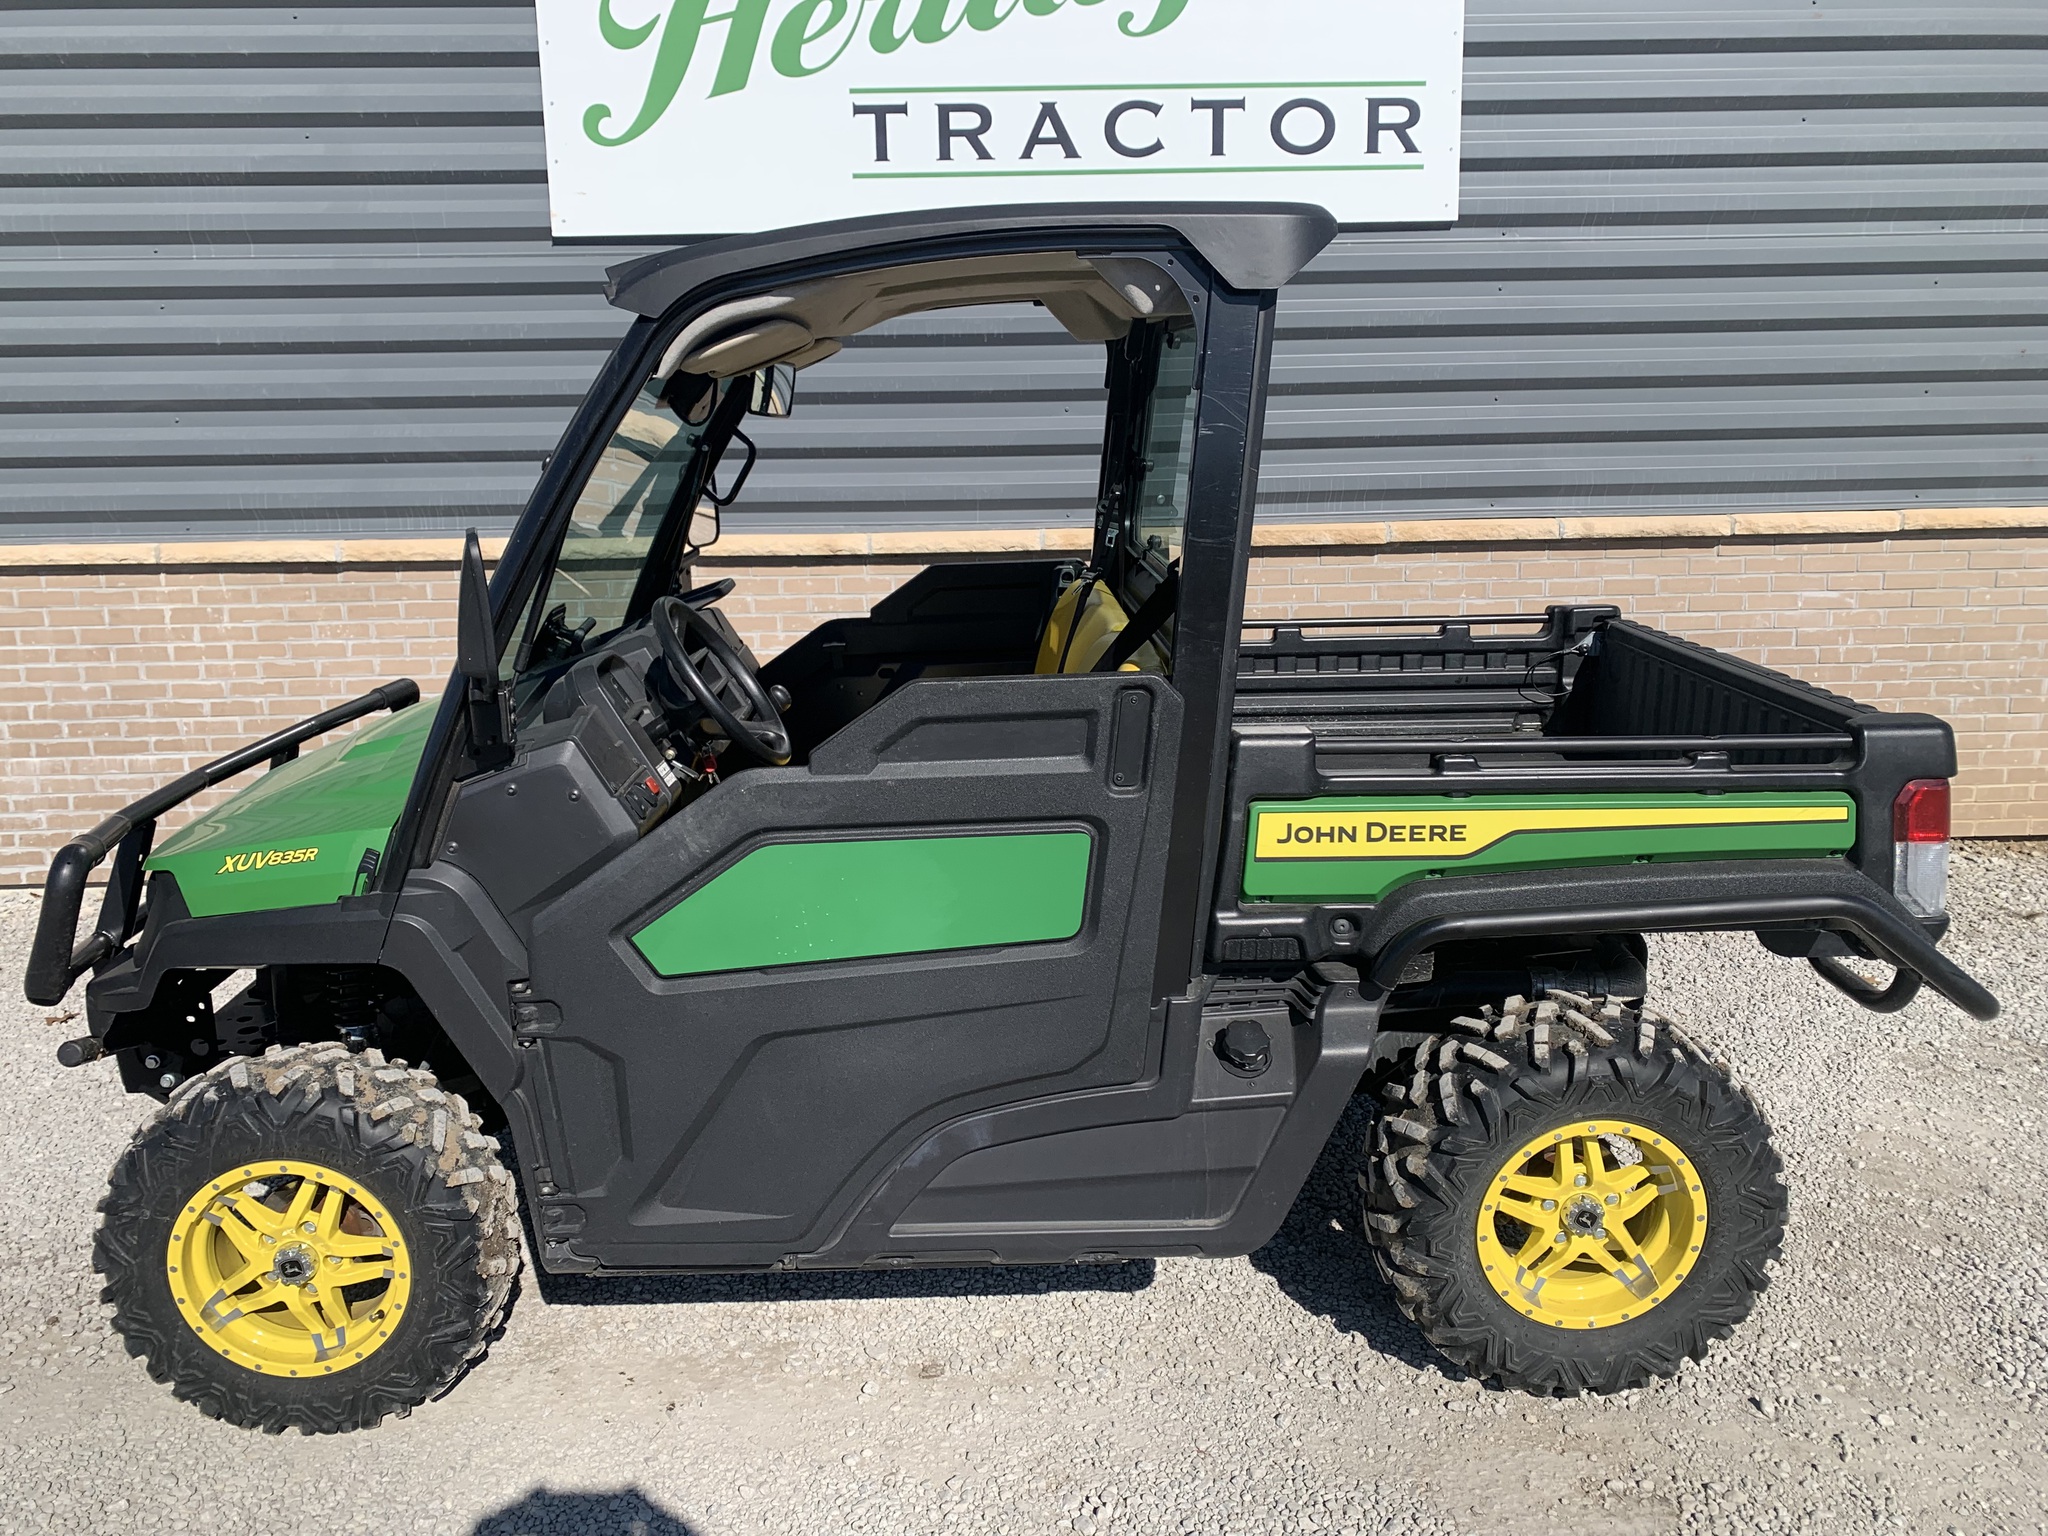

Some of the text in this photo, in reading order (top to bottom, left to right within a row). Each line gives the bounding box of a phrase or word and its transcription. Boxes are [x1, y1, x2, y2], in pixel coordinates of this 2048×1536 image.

[852, 96, 1421, 163] TRACTOR
[1276, 821, 1467, 844] JOHN DEERE
[216, 847, 319, 874] XUV835R
